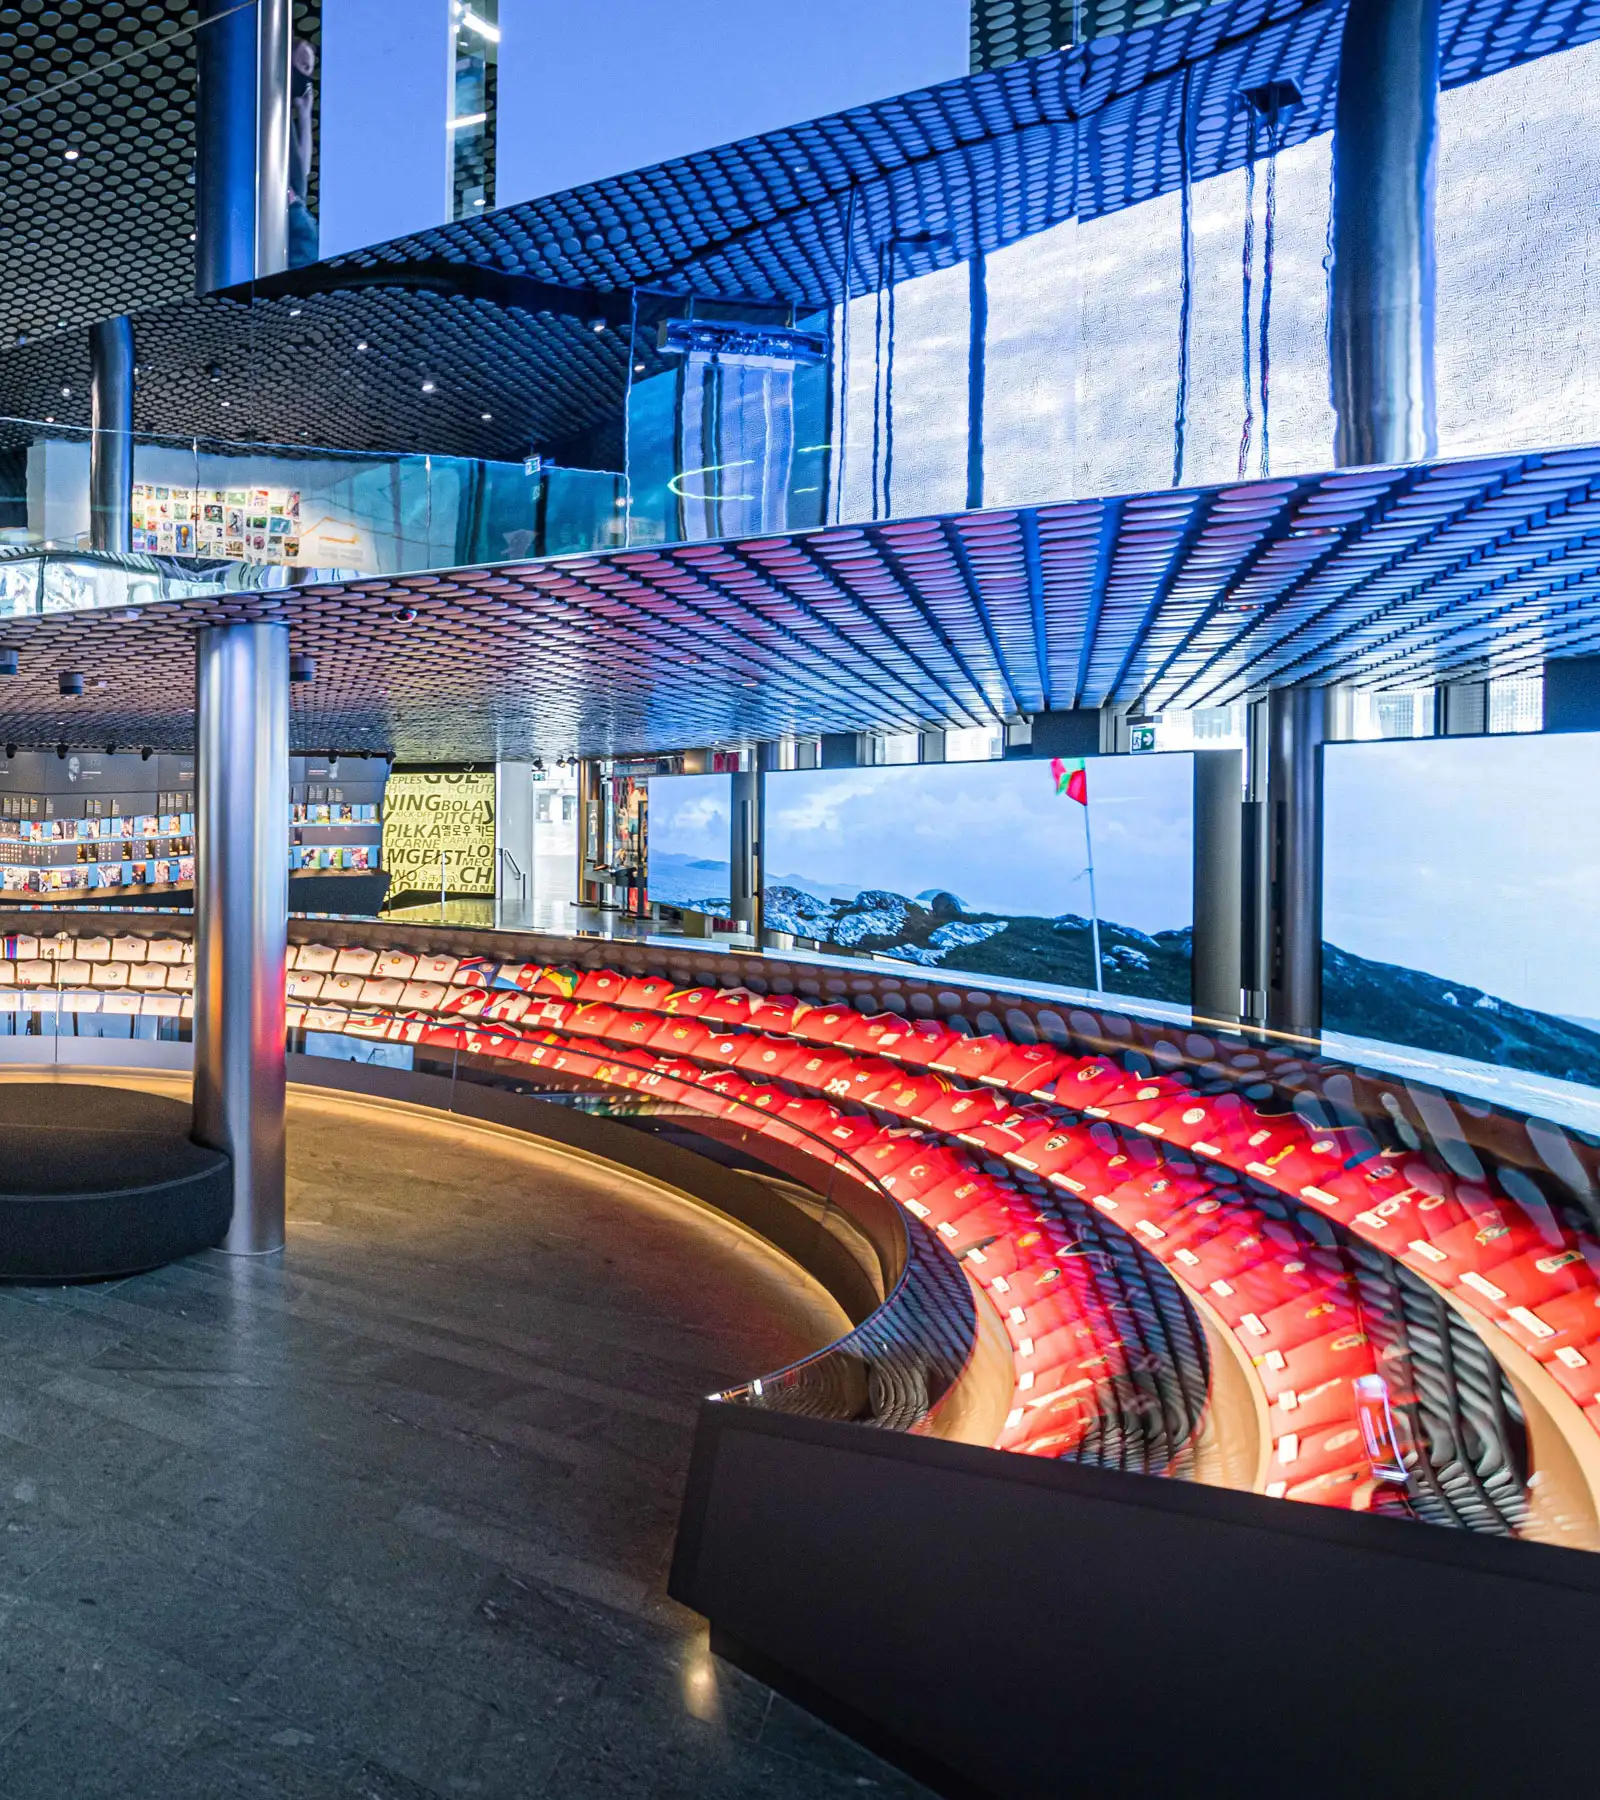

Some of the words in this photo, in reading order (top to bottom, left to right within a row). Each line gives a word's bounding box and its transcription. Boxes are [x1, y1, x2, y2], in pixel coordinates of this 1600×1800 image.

[388, 776, 422, 785] EPLES
[442, 800, 483, 811] BOLA
[433, 812, 483, 825] PITCH
[385, 824, 441, 838] PIŁKA
[377, 963, 386, 975] 5
